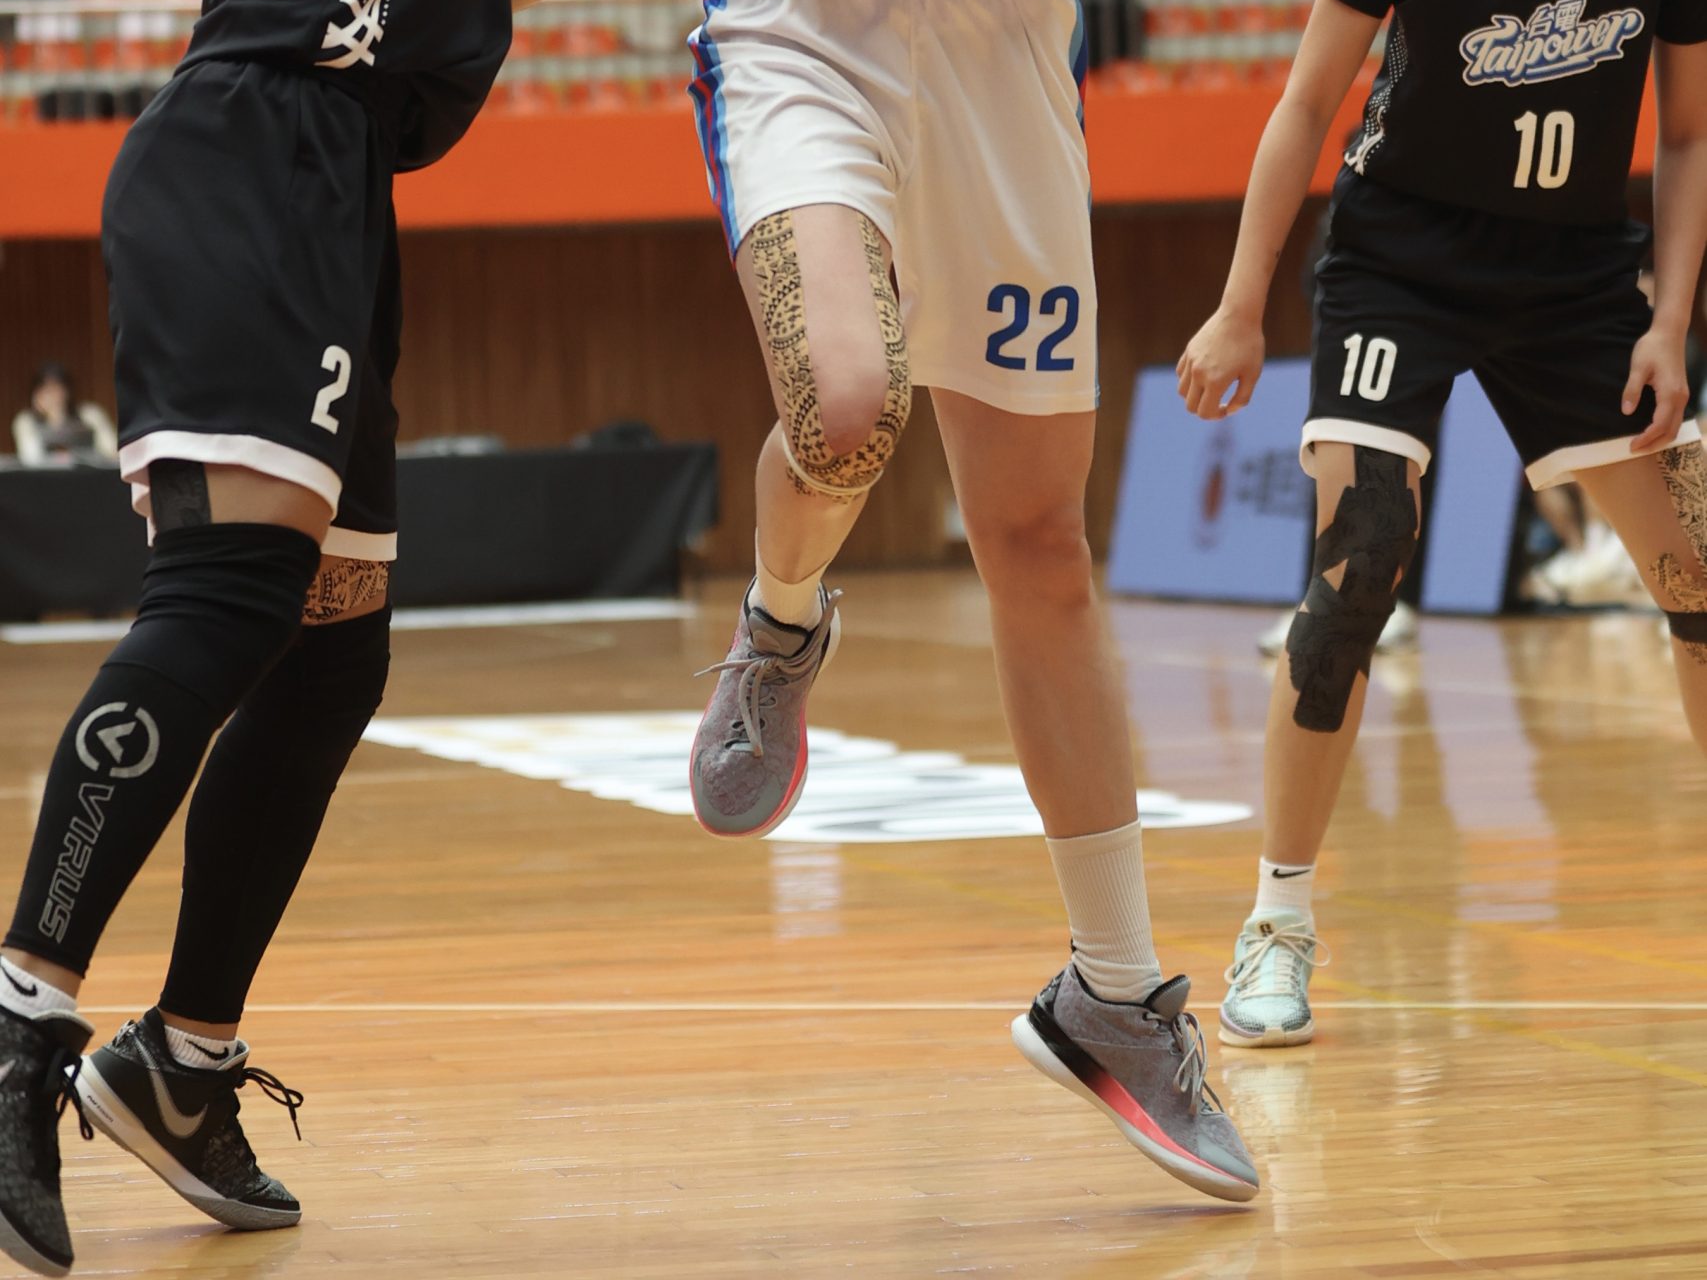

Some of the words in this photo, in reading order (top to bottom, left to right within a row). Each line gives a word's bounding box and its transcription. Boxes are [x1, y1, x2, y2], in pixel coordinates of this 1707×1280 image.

[1461, 8, 1643, 82] Taipower
[1526, 0, 1584, 40] 台電
[1513, 110, 1575, 189] 10
[985, 283, 1080, 372] 22
[1339, 332, 1398, 402] 10
[310, 344, 352, 436] 2
[38, 782, 115, 944] VIRUS
